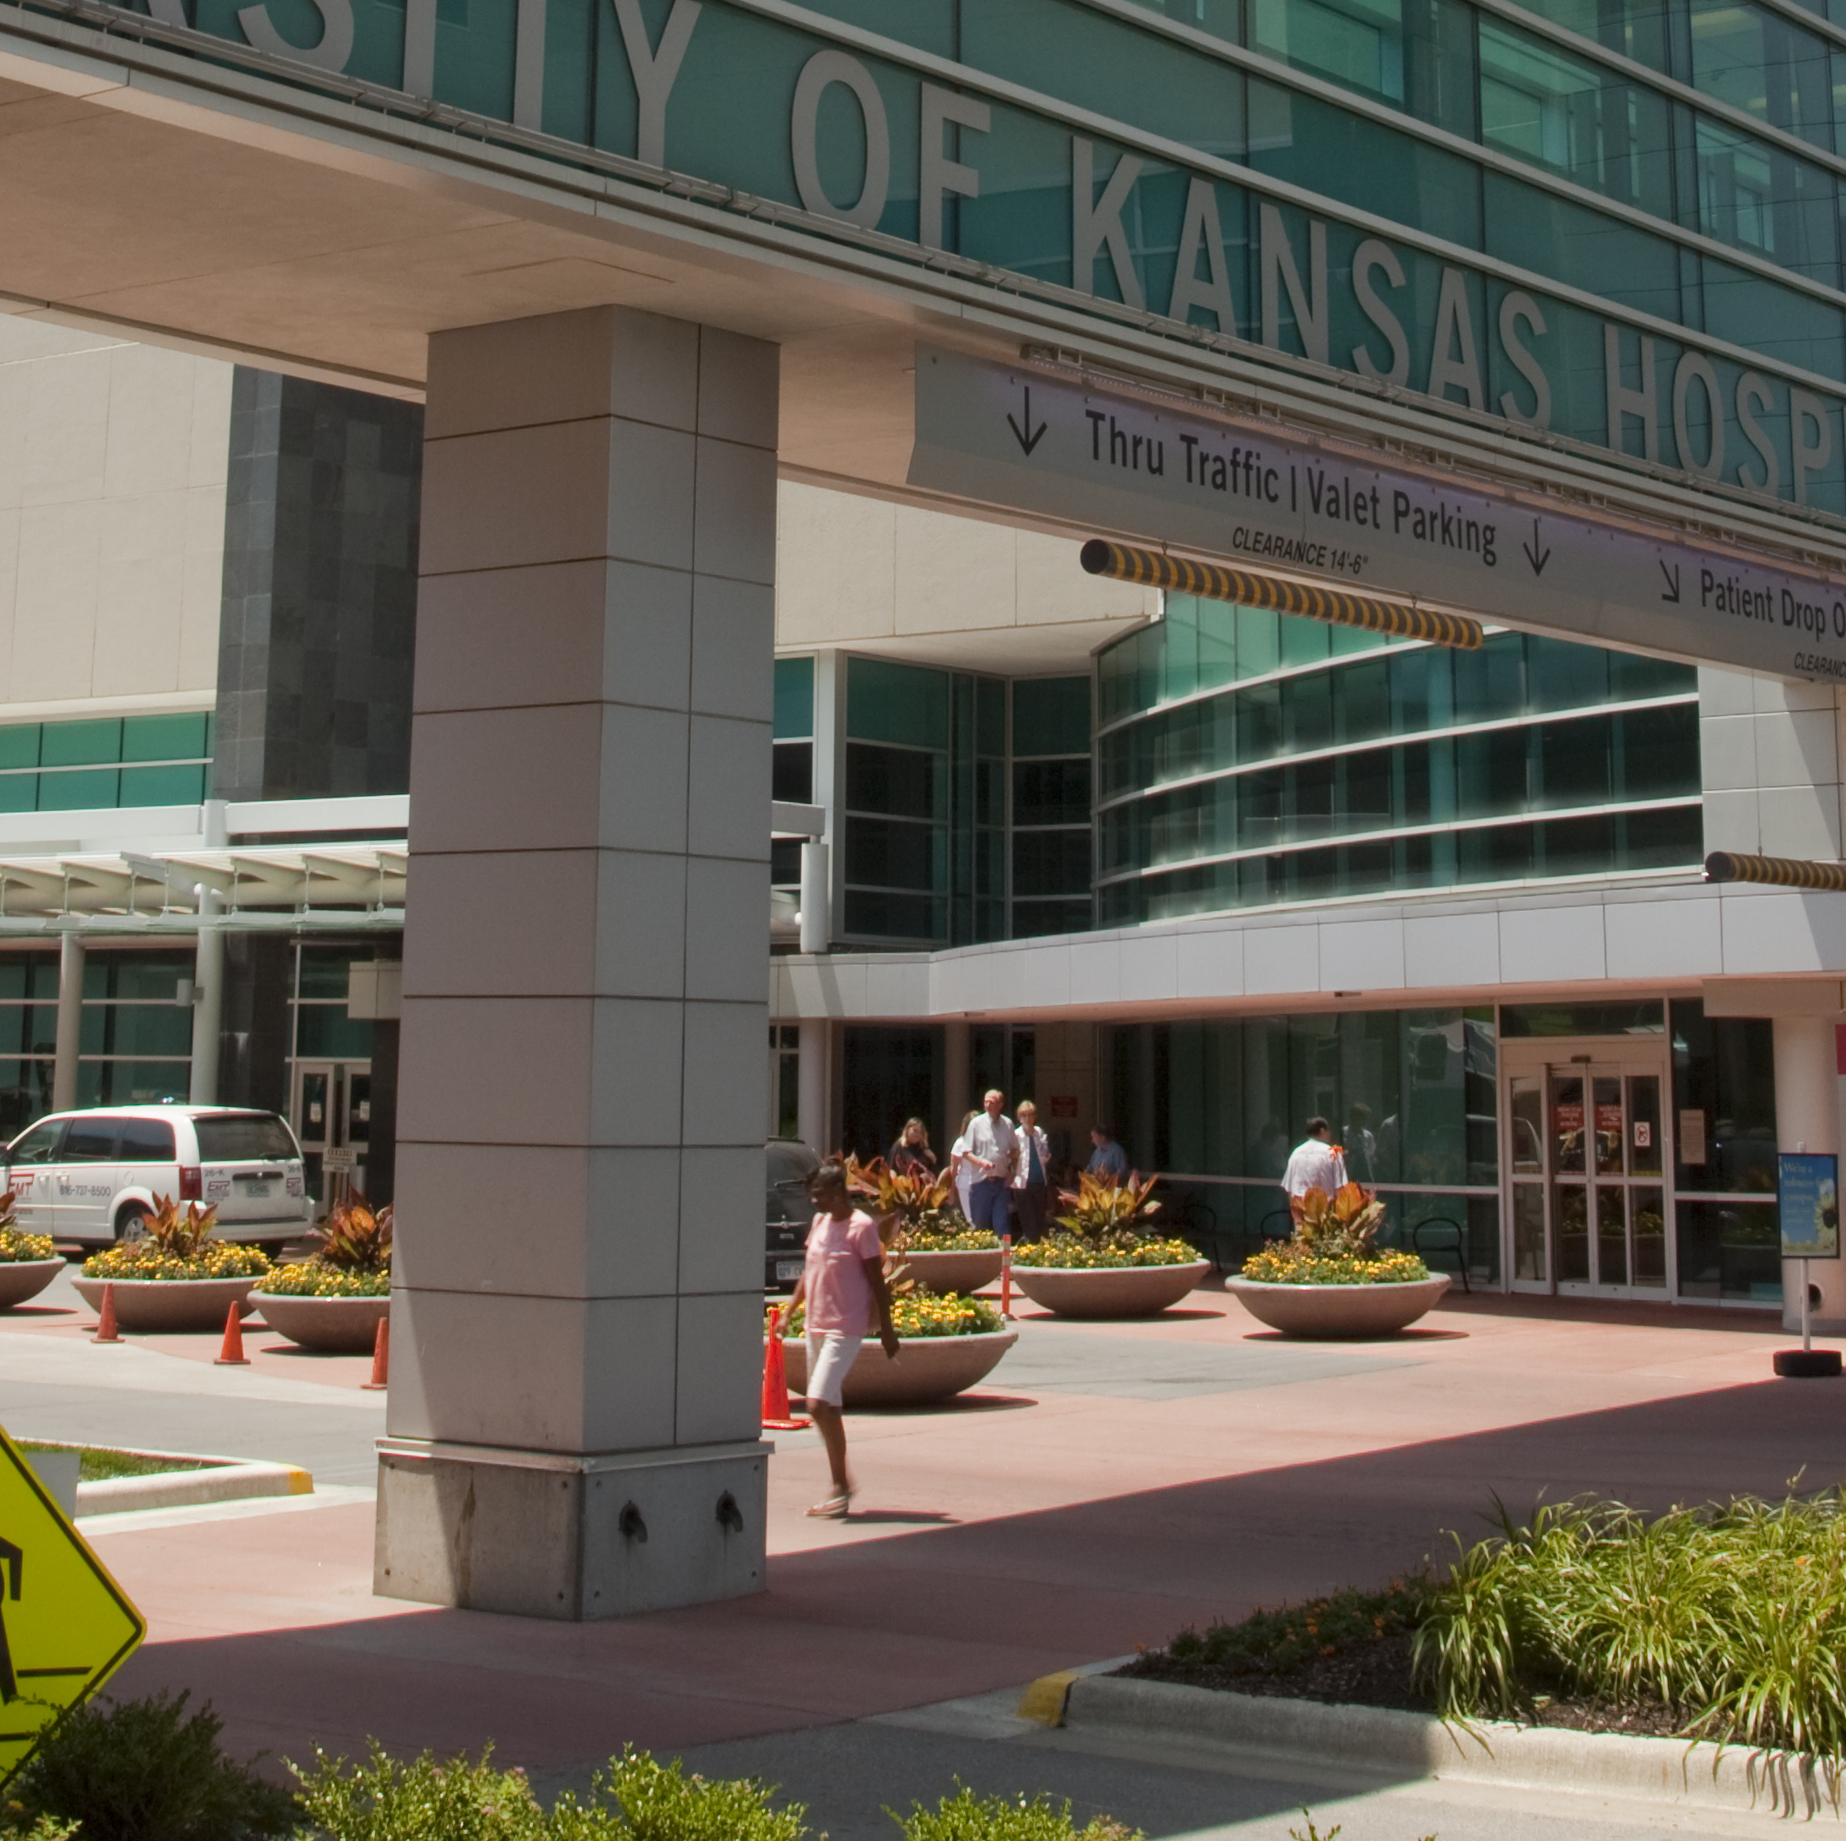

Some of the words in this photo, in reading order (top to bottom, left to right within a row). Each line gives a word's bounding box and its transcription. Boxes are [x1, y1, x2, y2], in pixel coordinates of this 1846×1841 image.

[790, 48, 992, 254] OF
[1072, 134, 1553, 433] KANSAS
[1084, 408, 1165, 478] Thru
[1179, 432, 1280, 504] Traffic
[1306, 460, 1381, 530] Valet
[1393, 490, 1497, 567] Parking
[1232, 526, 1328, 567] CLEARANCE
[1701, 569, 1775, 622] Patient
[1781, 589, 1826, 642] Drop
